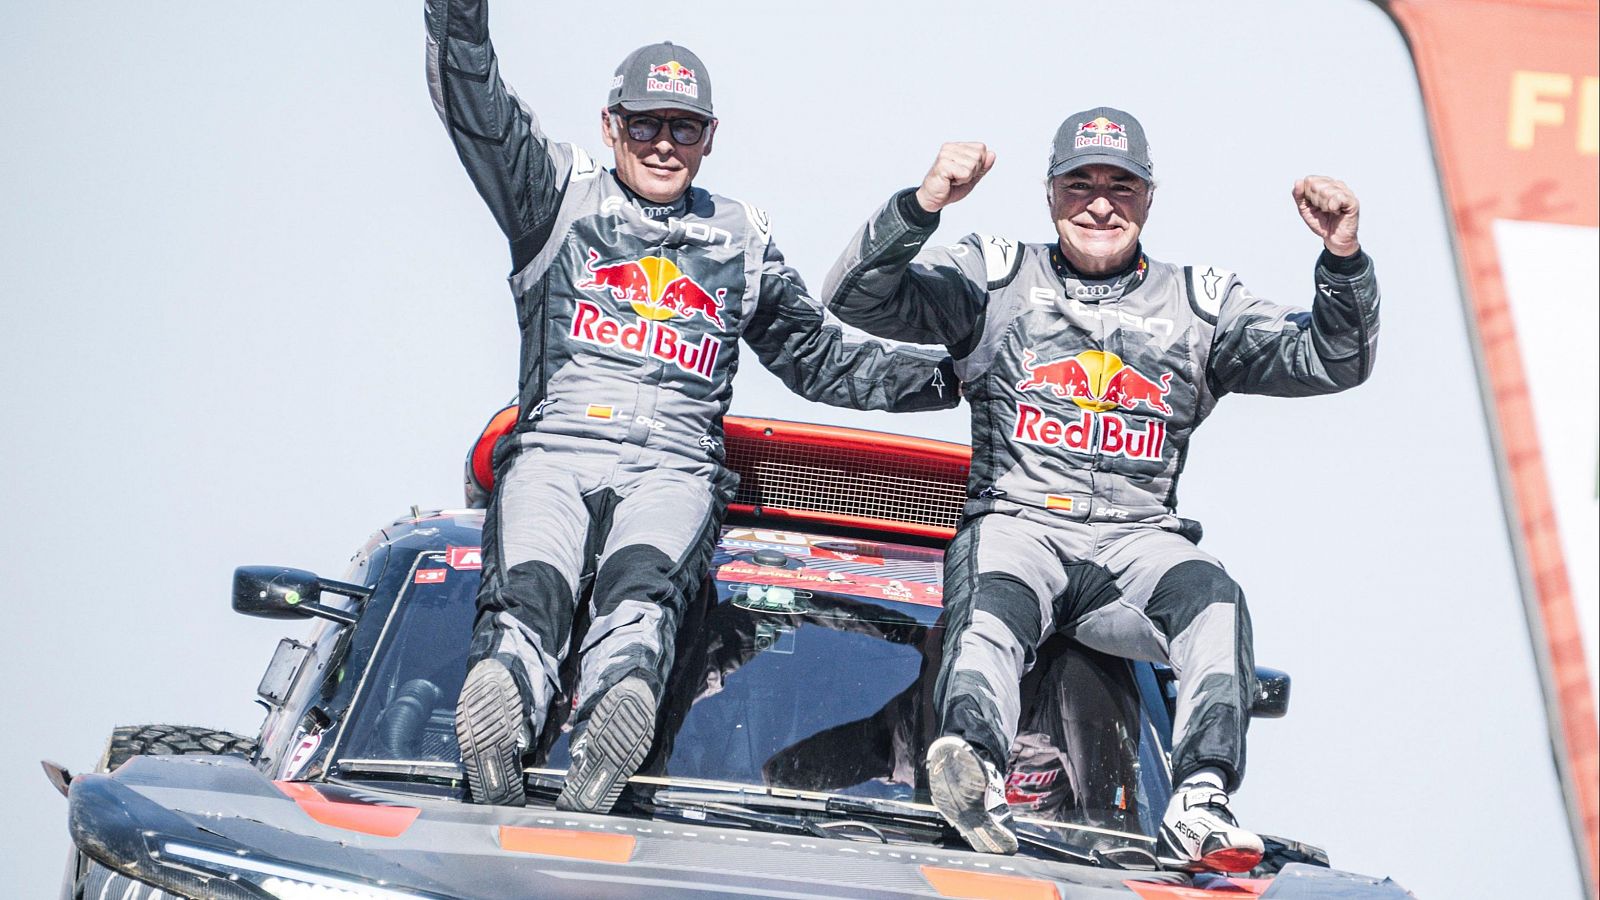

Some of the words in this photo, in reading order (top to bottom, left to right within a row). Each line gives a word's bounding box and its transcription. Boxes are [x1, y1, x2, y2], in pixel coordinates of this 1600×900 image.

[647, 78, 673, 92] Red
[675, 81, 698, 98] Bull
[1075, 135, 1100, 148] Red
[1102, 135, 1128, 151] Bull
[569, 299, 649, 357] Red
[648, 321, 721, 381] Bull
[1012, 401, 1095, 453] Red
[1098, 412, 1167, 461] Bull
